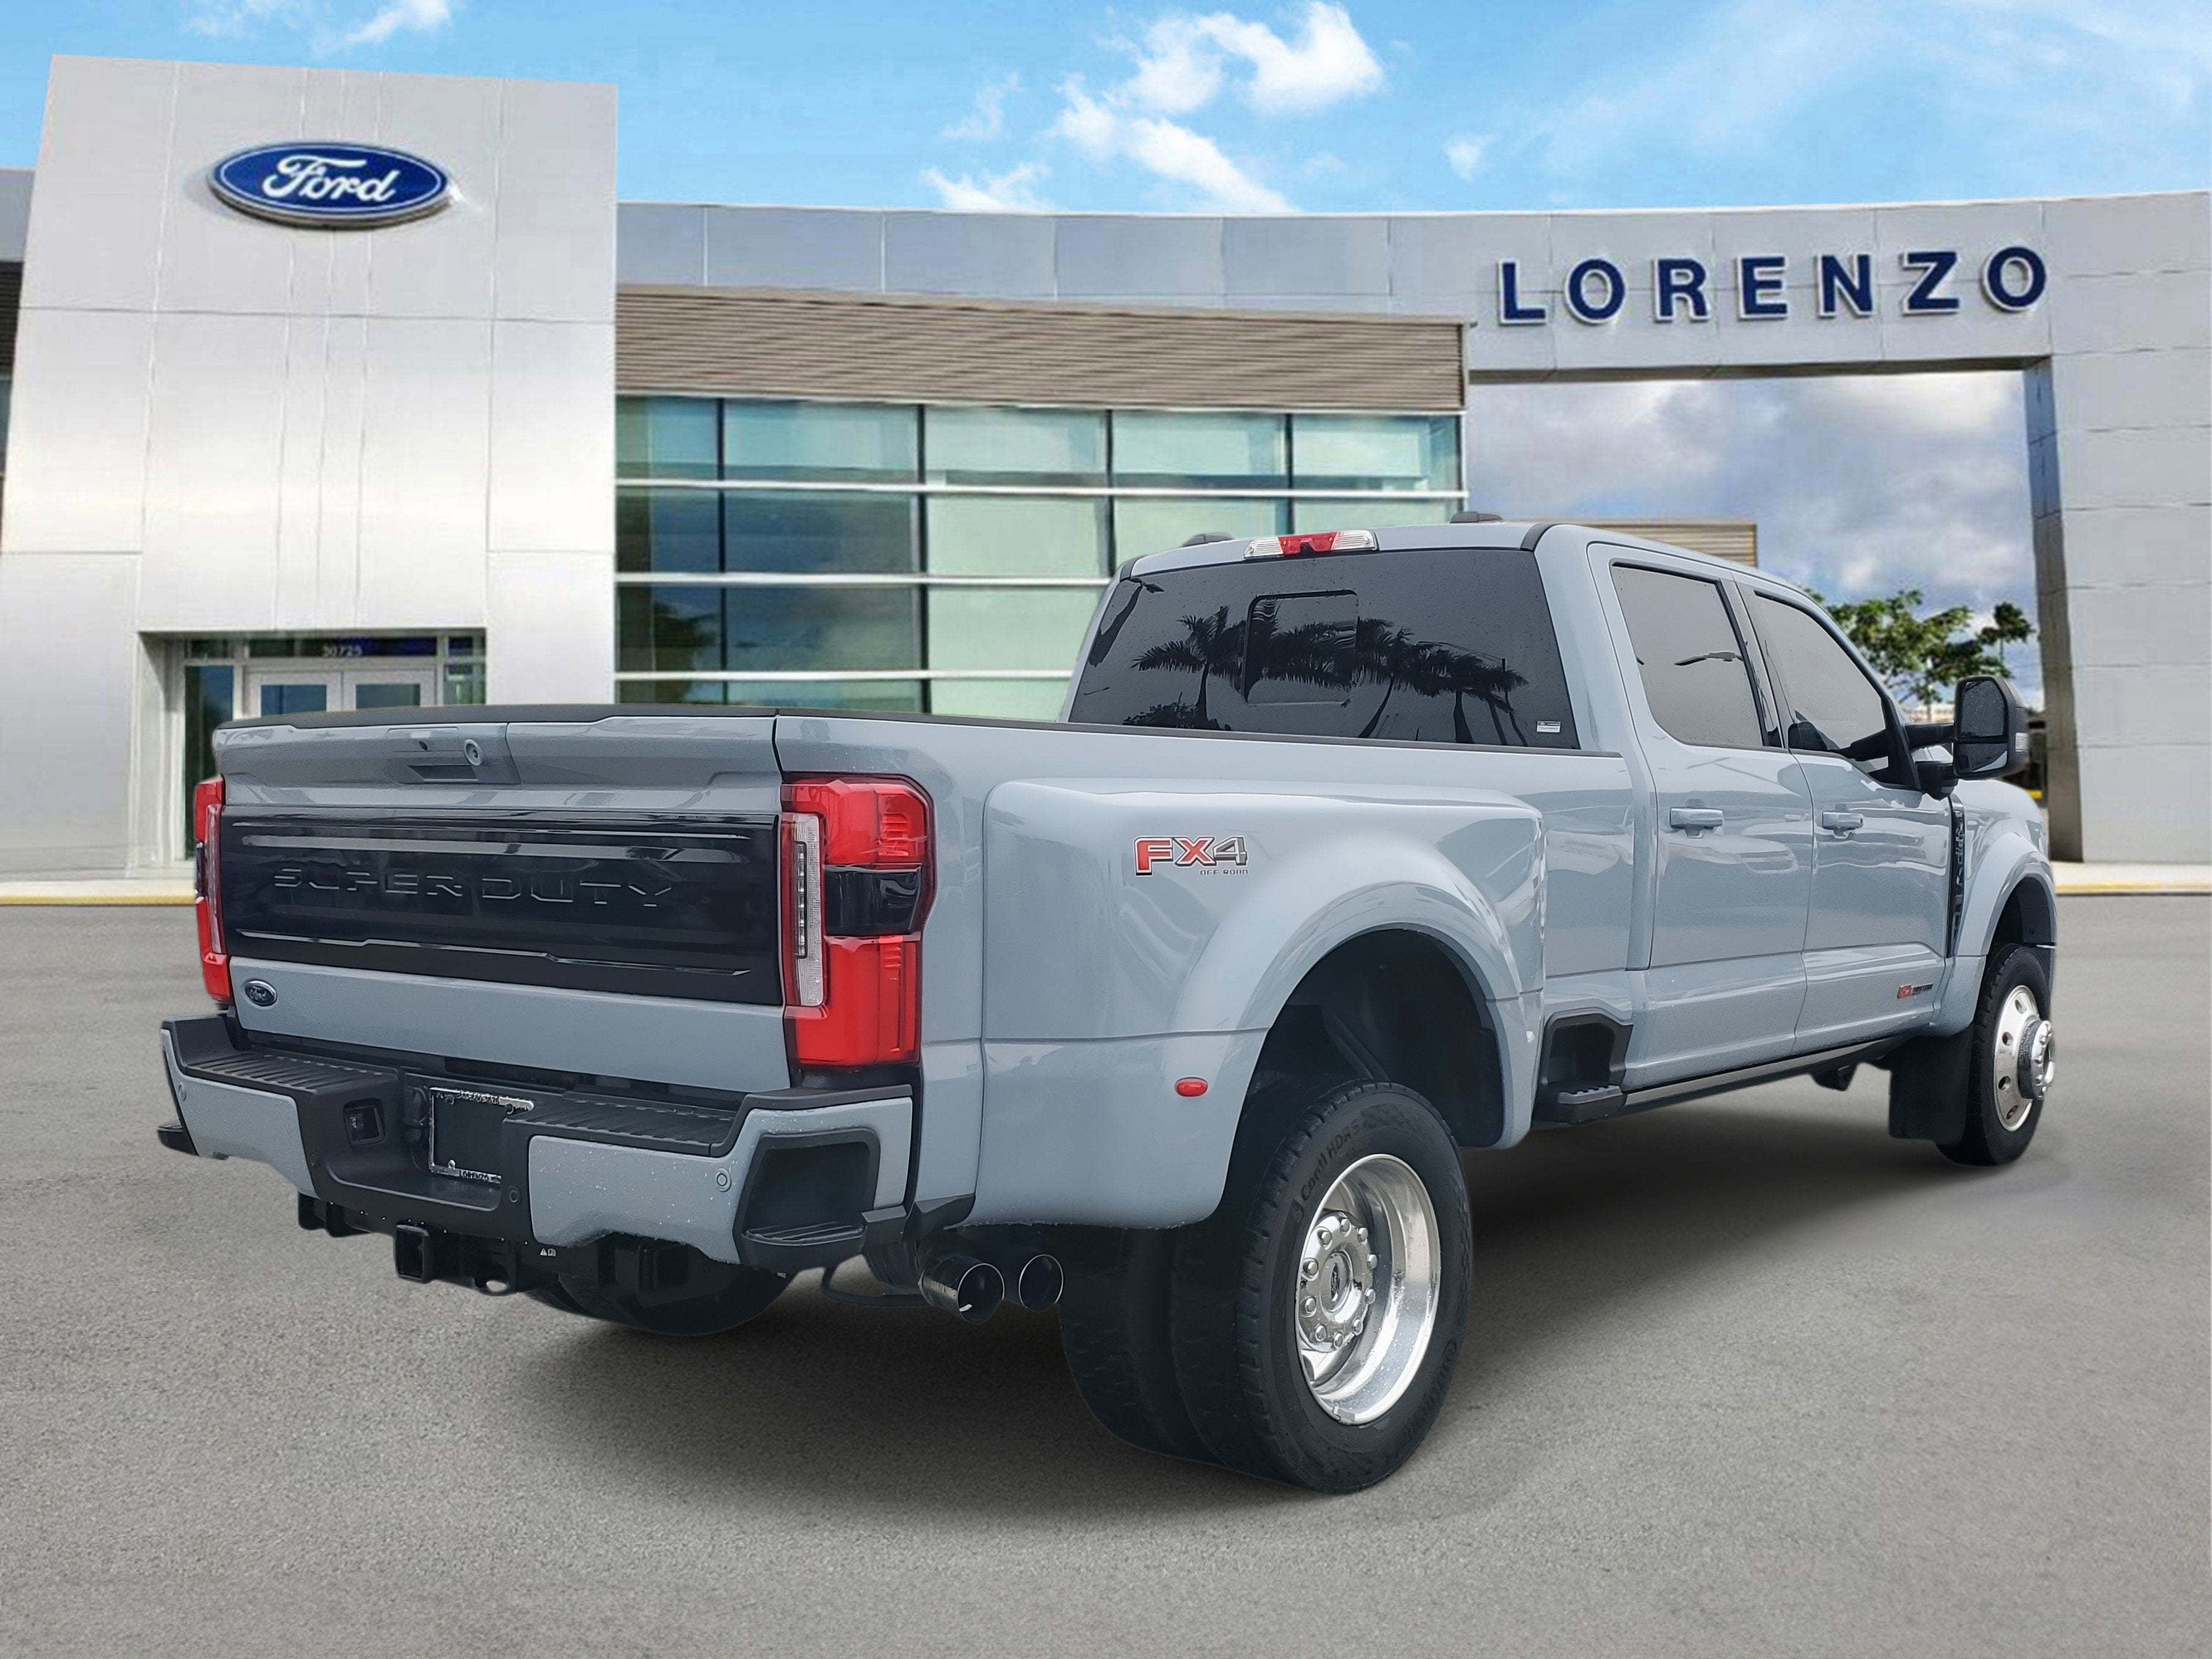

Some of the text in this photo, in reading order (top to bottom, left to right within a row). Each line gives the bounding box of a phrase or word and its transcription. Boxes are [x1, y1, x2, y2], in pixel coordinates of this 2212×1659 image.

[262, 155, 401, 202] Ford
[1496, 246, 2047, 324] LORENZO
[1134, 836, 1248, 877] FX4
[273, 867, 672, 908] SUPER DUTY
